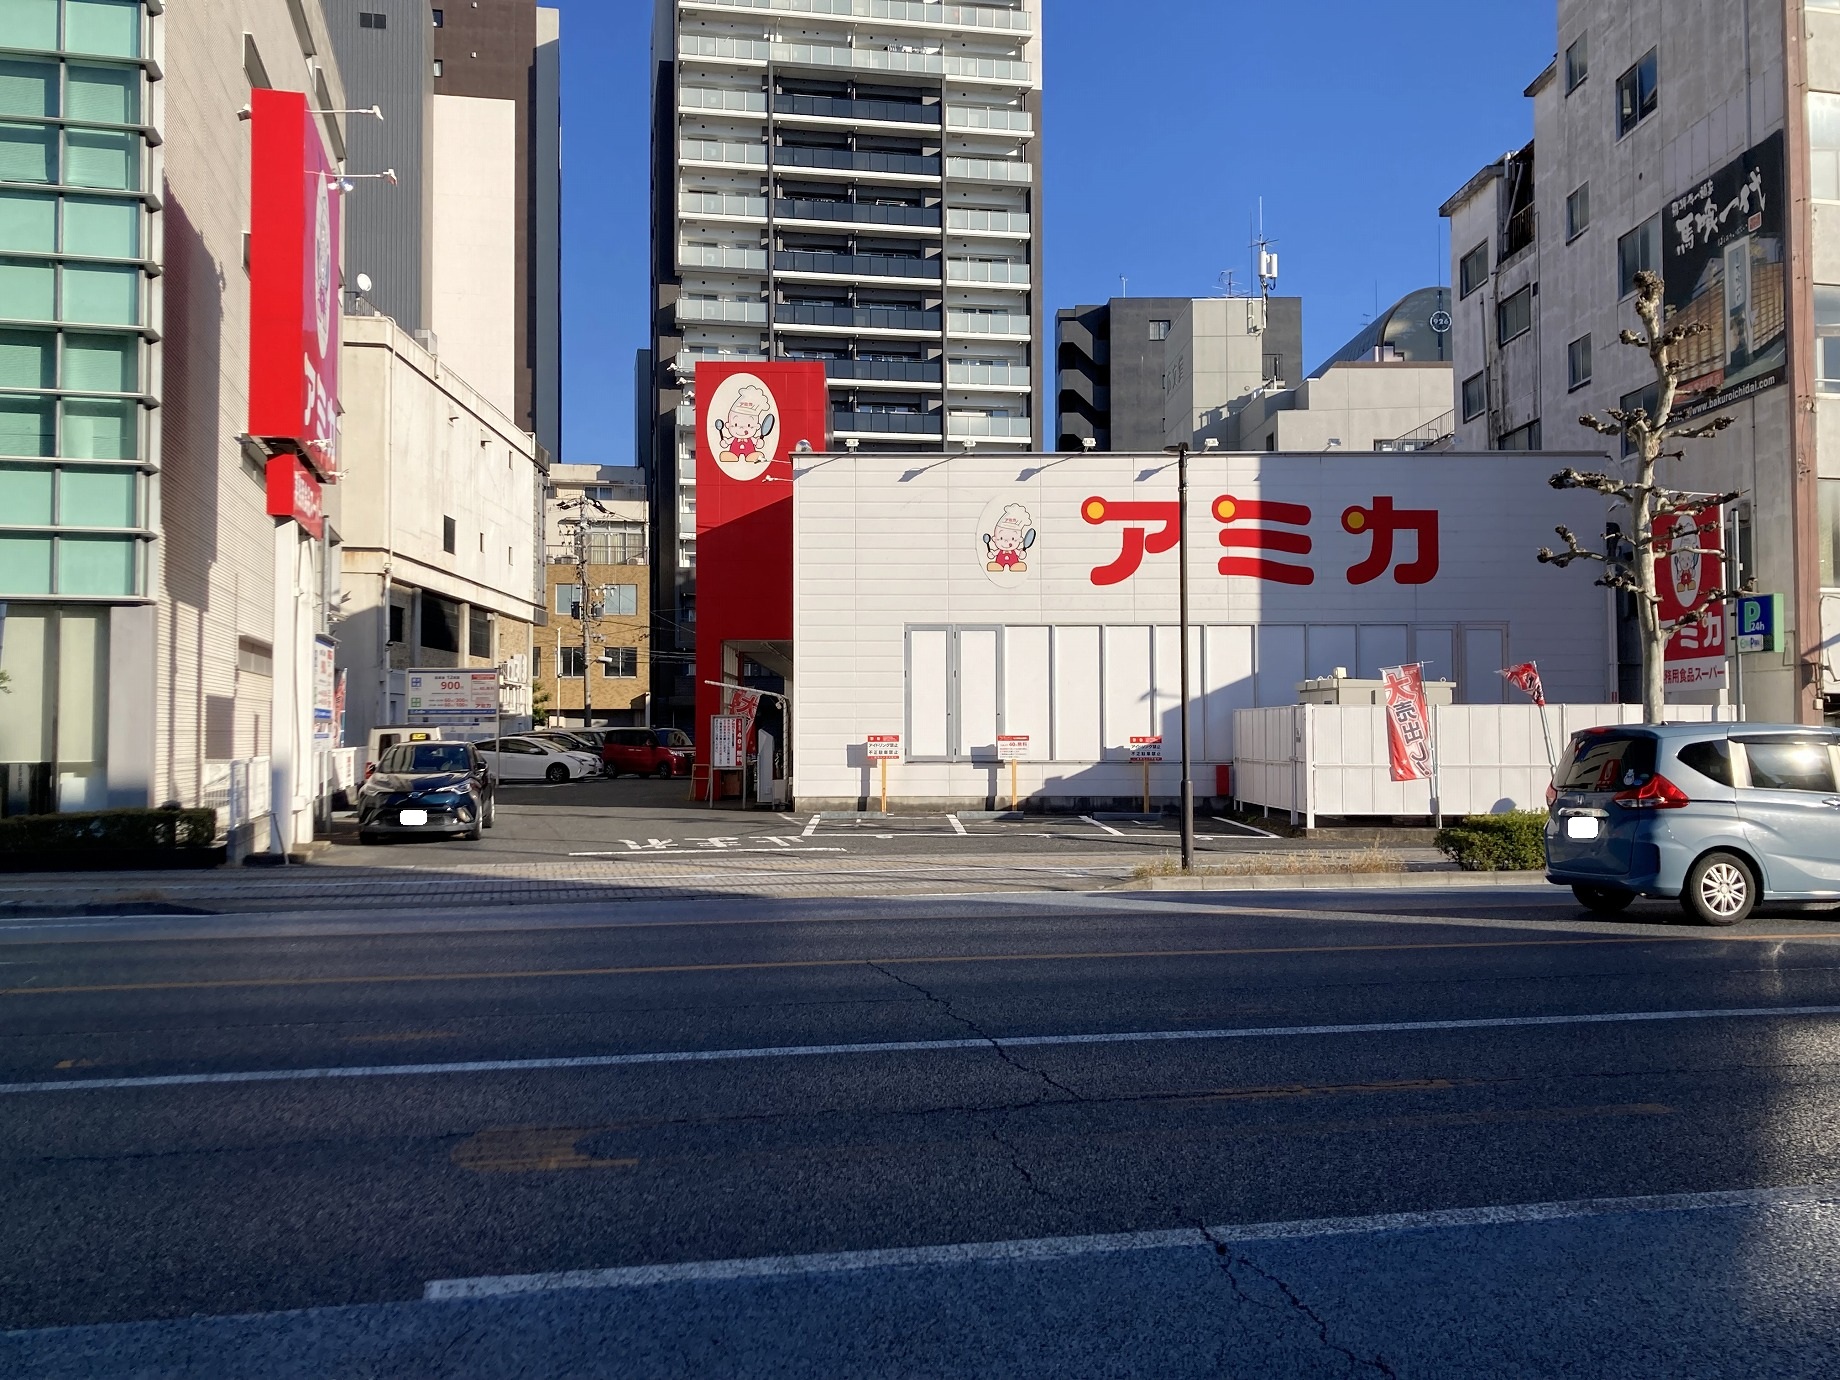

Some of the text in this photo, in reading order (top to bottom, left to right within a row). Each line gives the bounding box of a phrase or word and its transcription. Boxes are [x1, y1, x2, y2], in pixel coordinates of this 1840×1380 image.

[1081, 495, 1439, 585] アミカ
[1744, 601, 1761, 632] P
[1750, 621, 1765, 631] 24h
[618, 836, 804, 850] 止まれ
